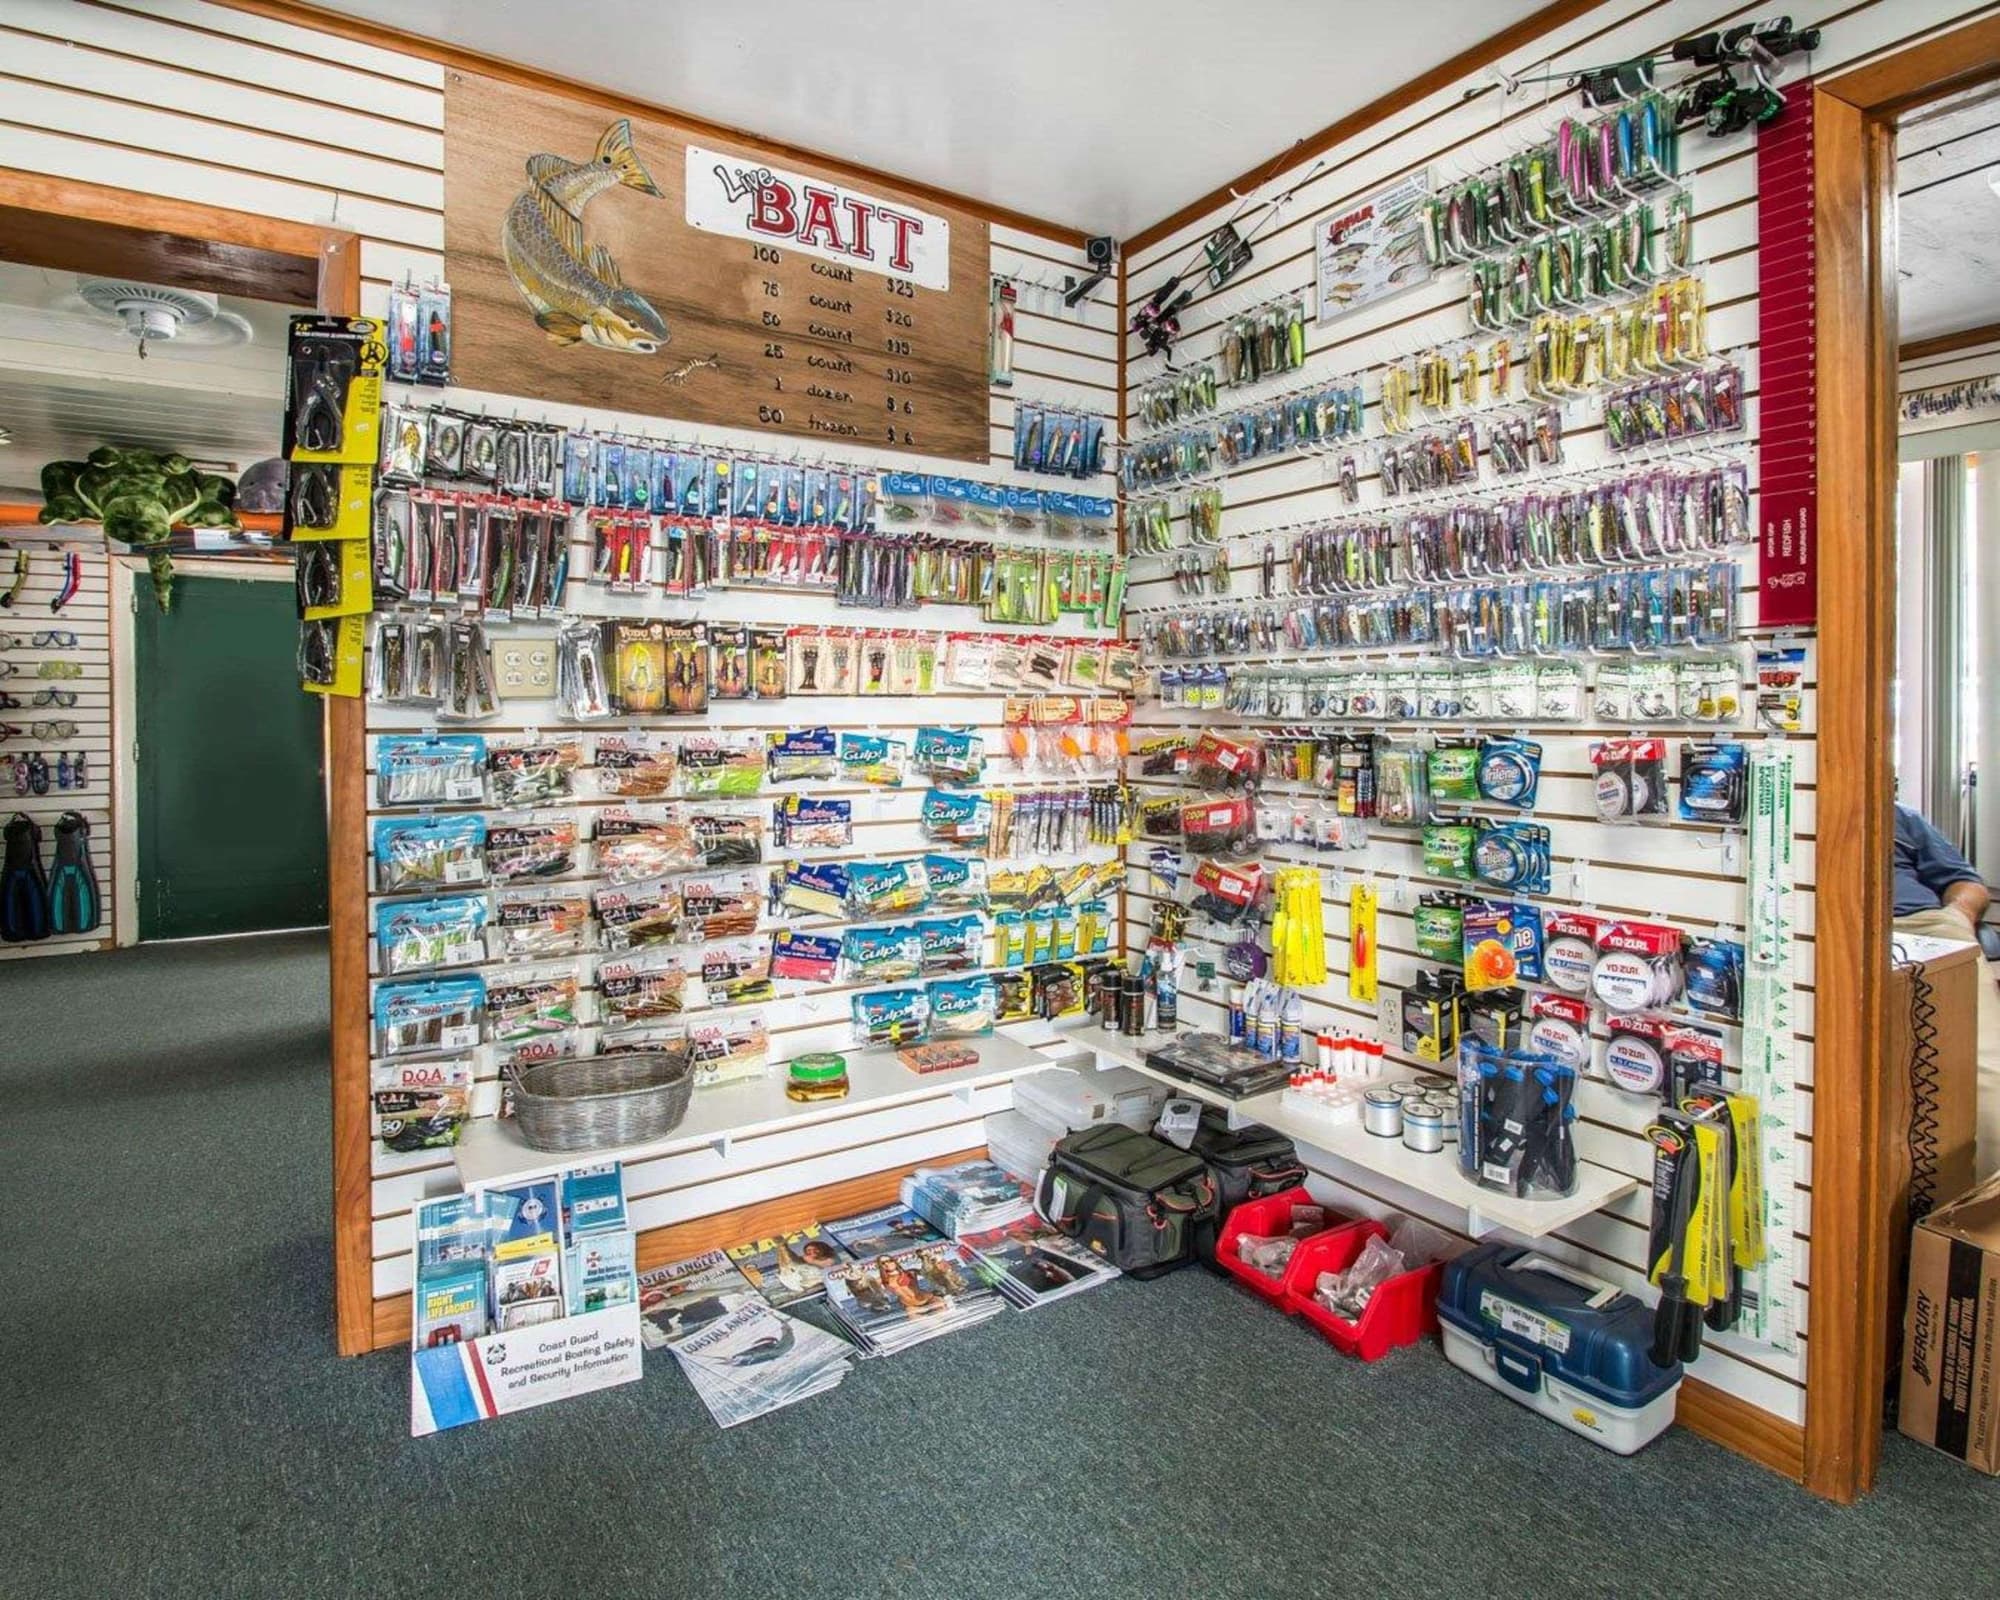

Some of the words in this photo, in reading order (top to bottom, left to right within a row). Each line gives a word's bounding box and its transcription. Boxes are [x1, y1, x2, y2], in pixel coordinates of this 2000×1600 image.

[714, 164, 775, 203] Live
[747, 181, 924, 273] BAIT
[753, 245, 780, 265] 100
[811, 262, 853, 283] count
[887, 278, 914, 299] $25
[762, 281, 779, 297] 75
[810, 294, 852, 314] count
[885, 309, 912, 328] $20
[762, 311, 781, 326] 50
[809, 323, 852, 343] count
[887, 338, 912, 355] $15
[764, 344, 784, 359] 25
[808, 354, 852, 373] count
[887, 368, 912, 385] $10
[774, 376, 782, 391] 1
[807, 385, 853, 403] dozen
[758, 406, 784, 424] 50
[807, 414, 858, 436] frozen
[1782, 518, 1793, 557] REDFISH
[843, 750, 882, 761] Gulp!
[931, 744, 964, 756] Gulp!
[929, 808, 968, 820] Gulp!
[929, 869, 963, 884] Gulp!
[1609, 936, 1649, 950] YO-ZURI
[402, 1069, 447, 1083] D.O.A.
[382, 1120, 401, 1132] 50
[676, 1254, 725, 1276] ANGLER
[681, 1327, 725, 1354] COASTAL
[725, 1304, 766, 1332] ANGLER
[1960, 1297, 1975, 1339] CONTROL
[539, 1340, 567, 1353] Coast
[570, 1331, 598, 1346] Guard
[1912, 1289, 1932, 1386] MERCURY
[501, 1353, 562, 1376] Recreational
[565, 1345, 601, 1361] Boating
[604, 1337, 635, 1351] Safety
[508, 1376, 526, 1389] and
[530, 1366, 571, 1385] Security
[574, 1353, 628, 1373] Information
